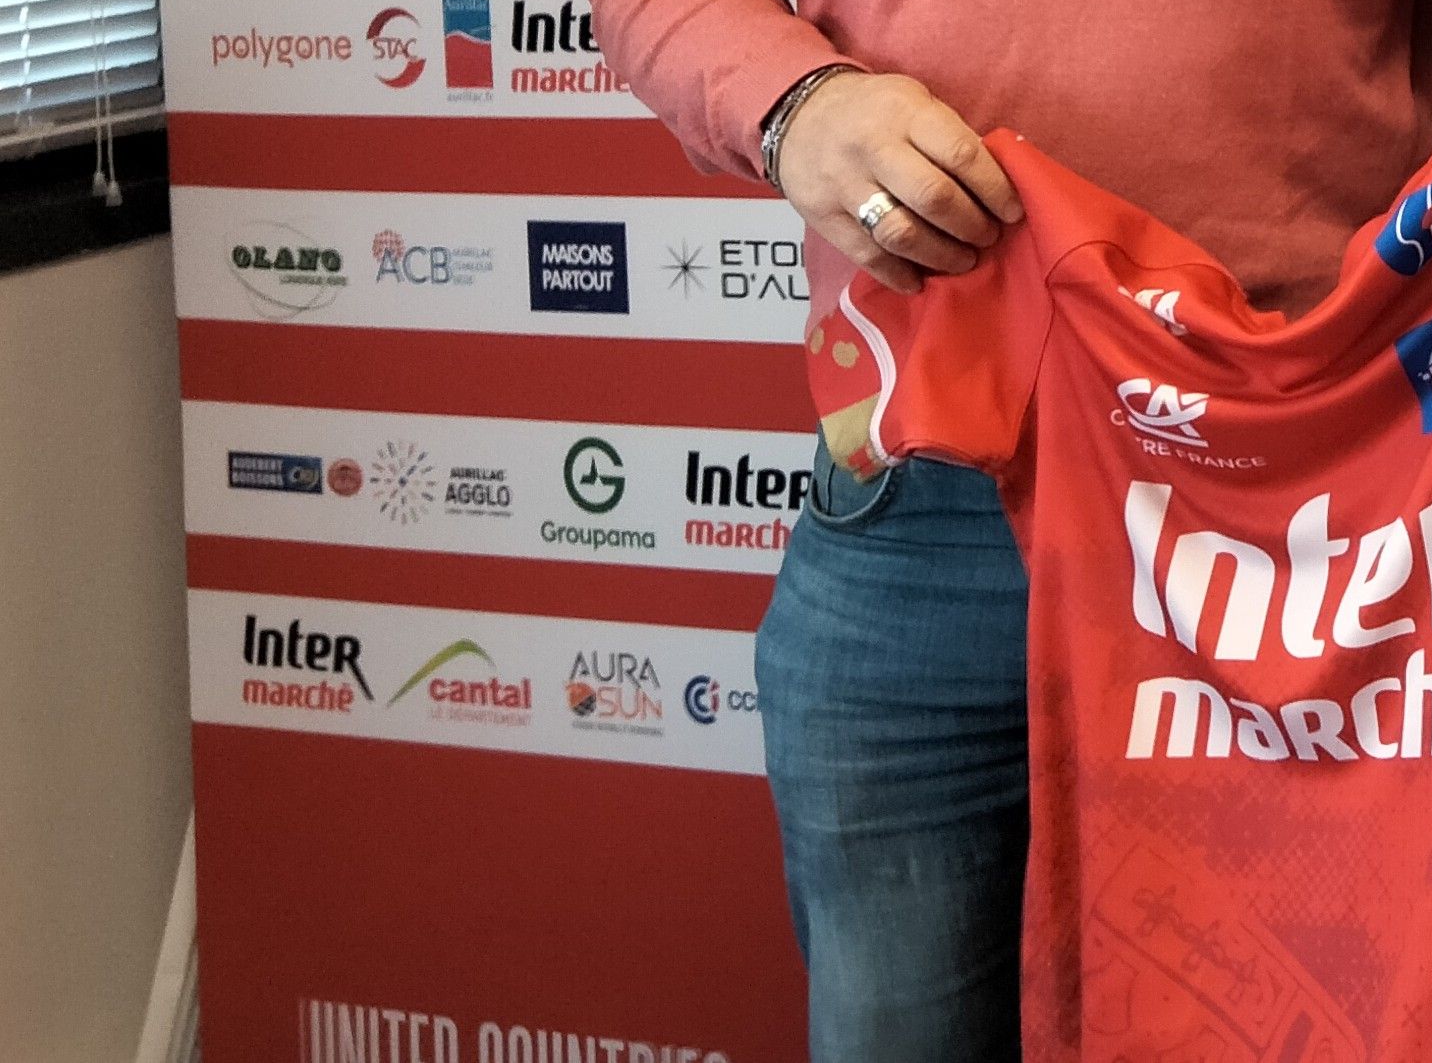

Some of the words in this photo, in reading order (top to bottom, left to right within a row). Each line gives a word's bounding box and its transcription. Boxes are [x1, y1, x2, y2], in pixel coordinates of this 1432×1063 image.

[211, 28, 352, 69] polygone
[372, 36, 418, 59] STAC
[232, 245, 342, 273] OLANO
[376, 246, 452, 285] ACB
[542, 244, 613, 266] MAISONS
[543, 269, 613, 291] PARTOUT
[445, 483, 510, 507] AGGLO
[540, 520, 655, 551] Groupama
[685, 517, 790, 551] march
[570, 651, 661, 688] AURA
[428, 675, 532, 709] cantal
[596, 686, 662, 719] SUN
[728, 690, 759, 711] CC
